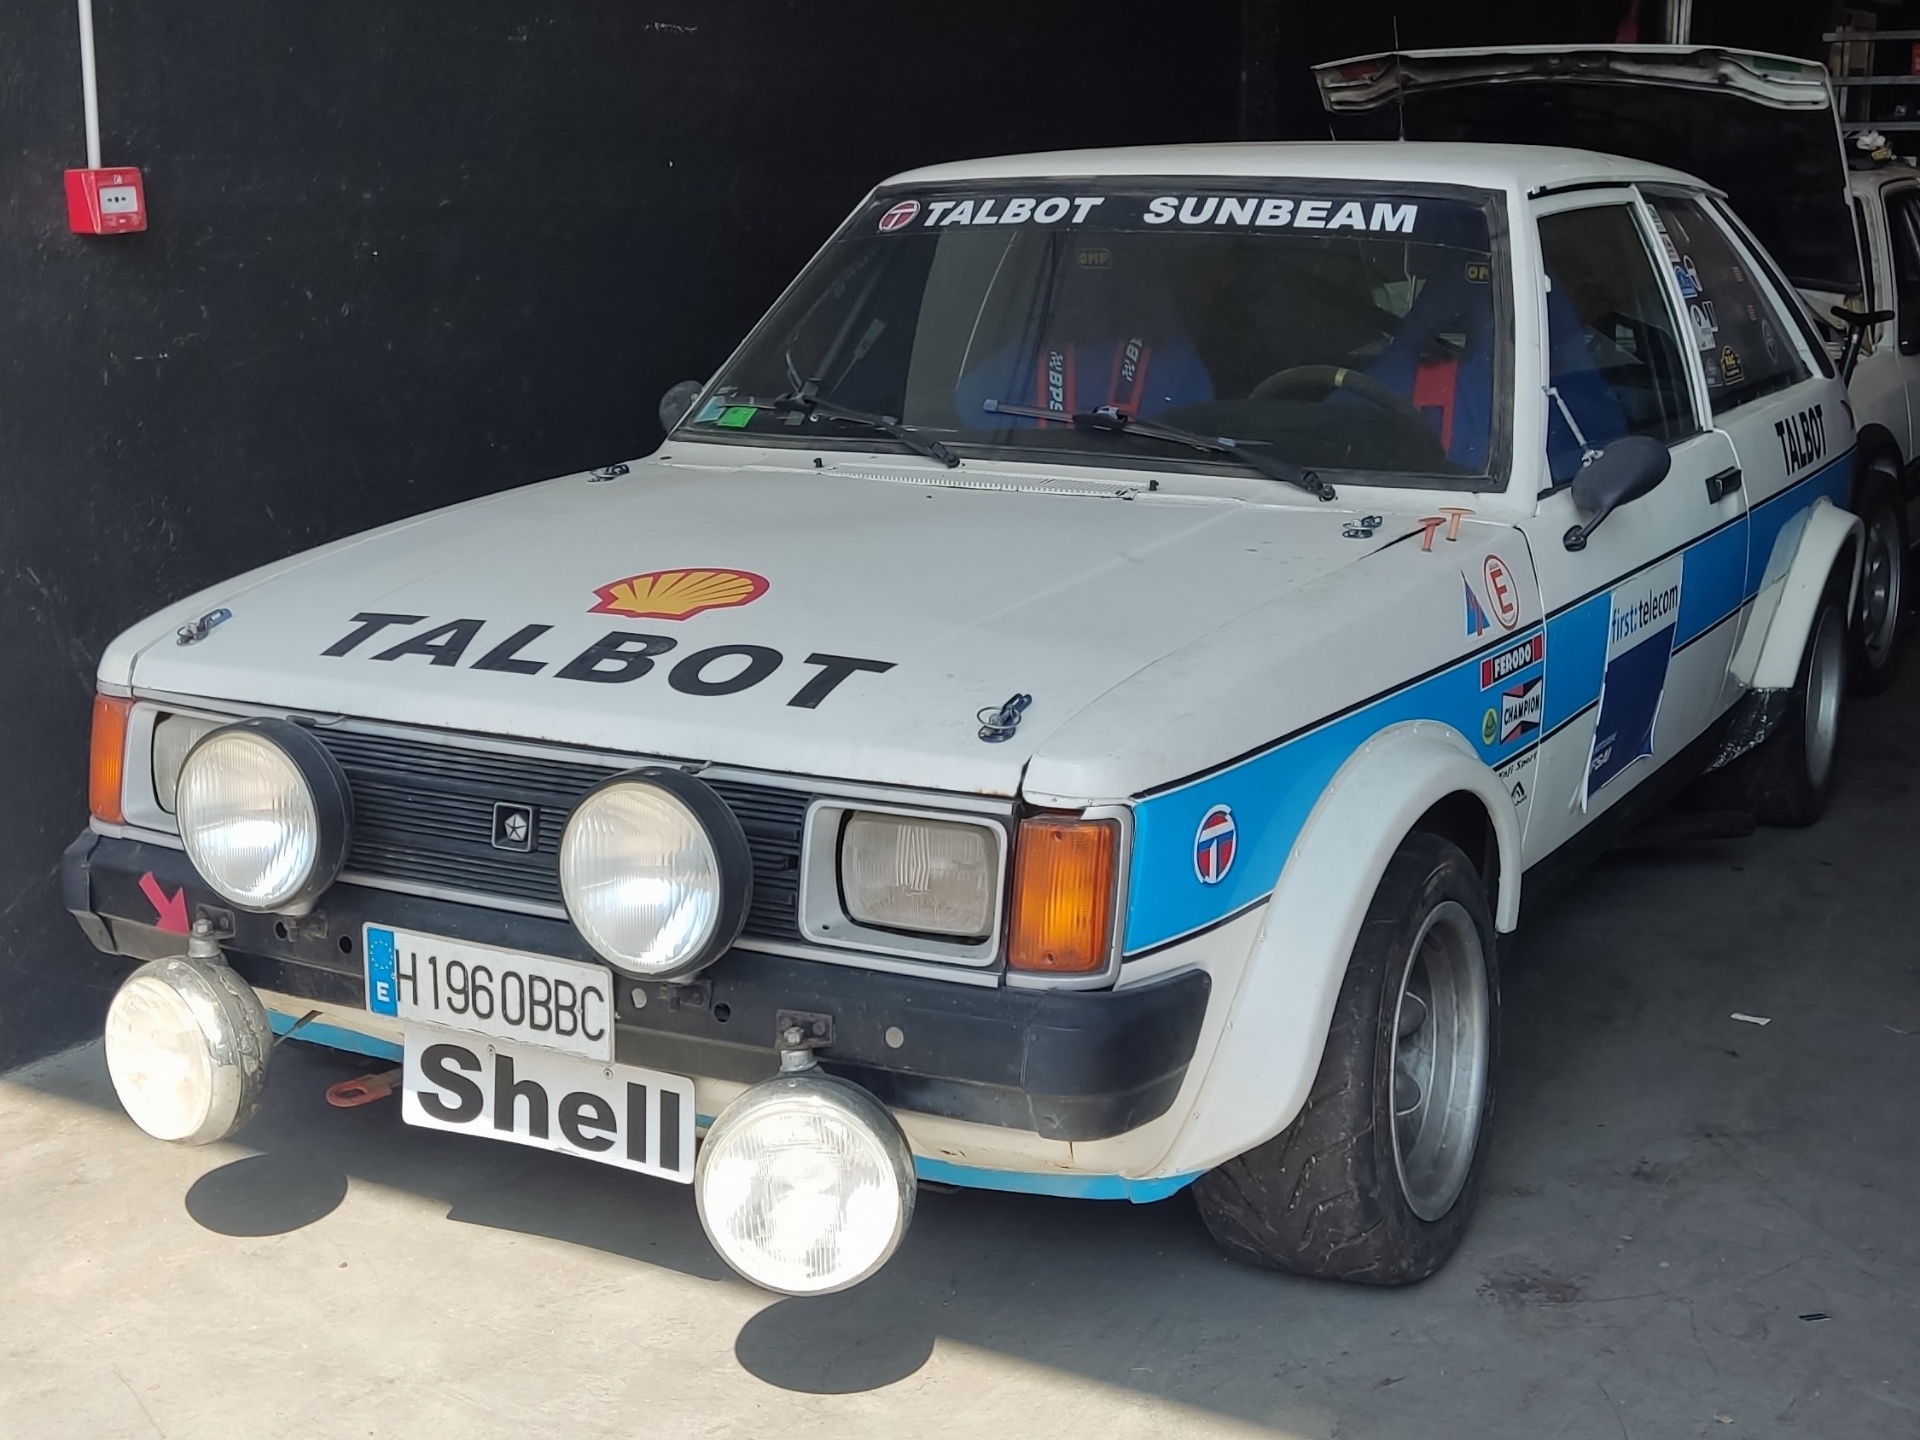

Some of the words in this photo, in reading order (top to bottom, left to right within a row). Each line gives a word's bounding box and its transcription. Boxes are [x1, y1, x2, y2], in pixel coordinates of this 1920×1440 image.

[924, 197, 1105, 227] TALBOT
[1143, 197, 1418, 233] SUNBEAM
[1079, 251, 1108, 265] OMP
[1468, 266, 1489, 280] OM
[1774, 403, 1827, 476] TALBOT
[1490, 568, 1514, 614] E
[319, 612, 898, 709] TALBOT
[1494, 643, 1532, 679] FERODO
[1504, 694, 1541, 725] CHAMPION
[376, 982, 391, 1002] E
[395, 948, 605, 1041] H1960BBC
[417, 1043, 680, 1172] Shell
